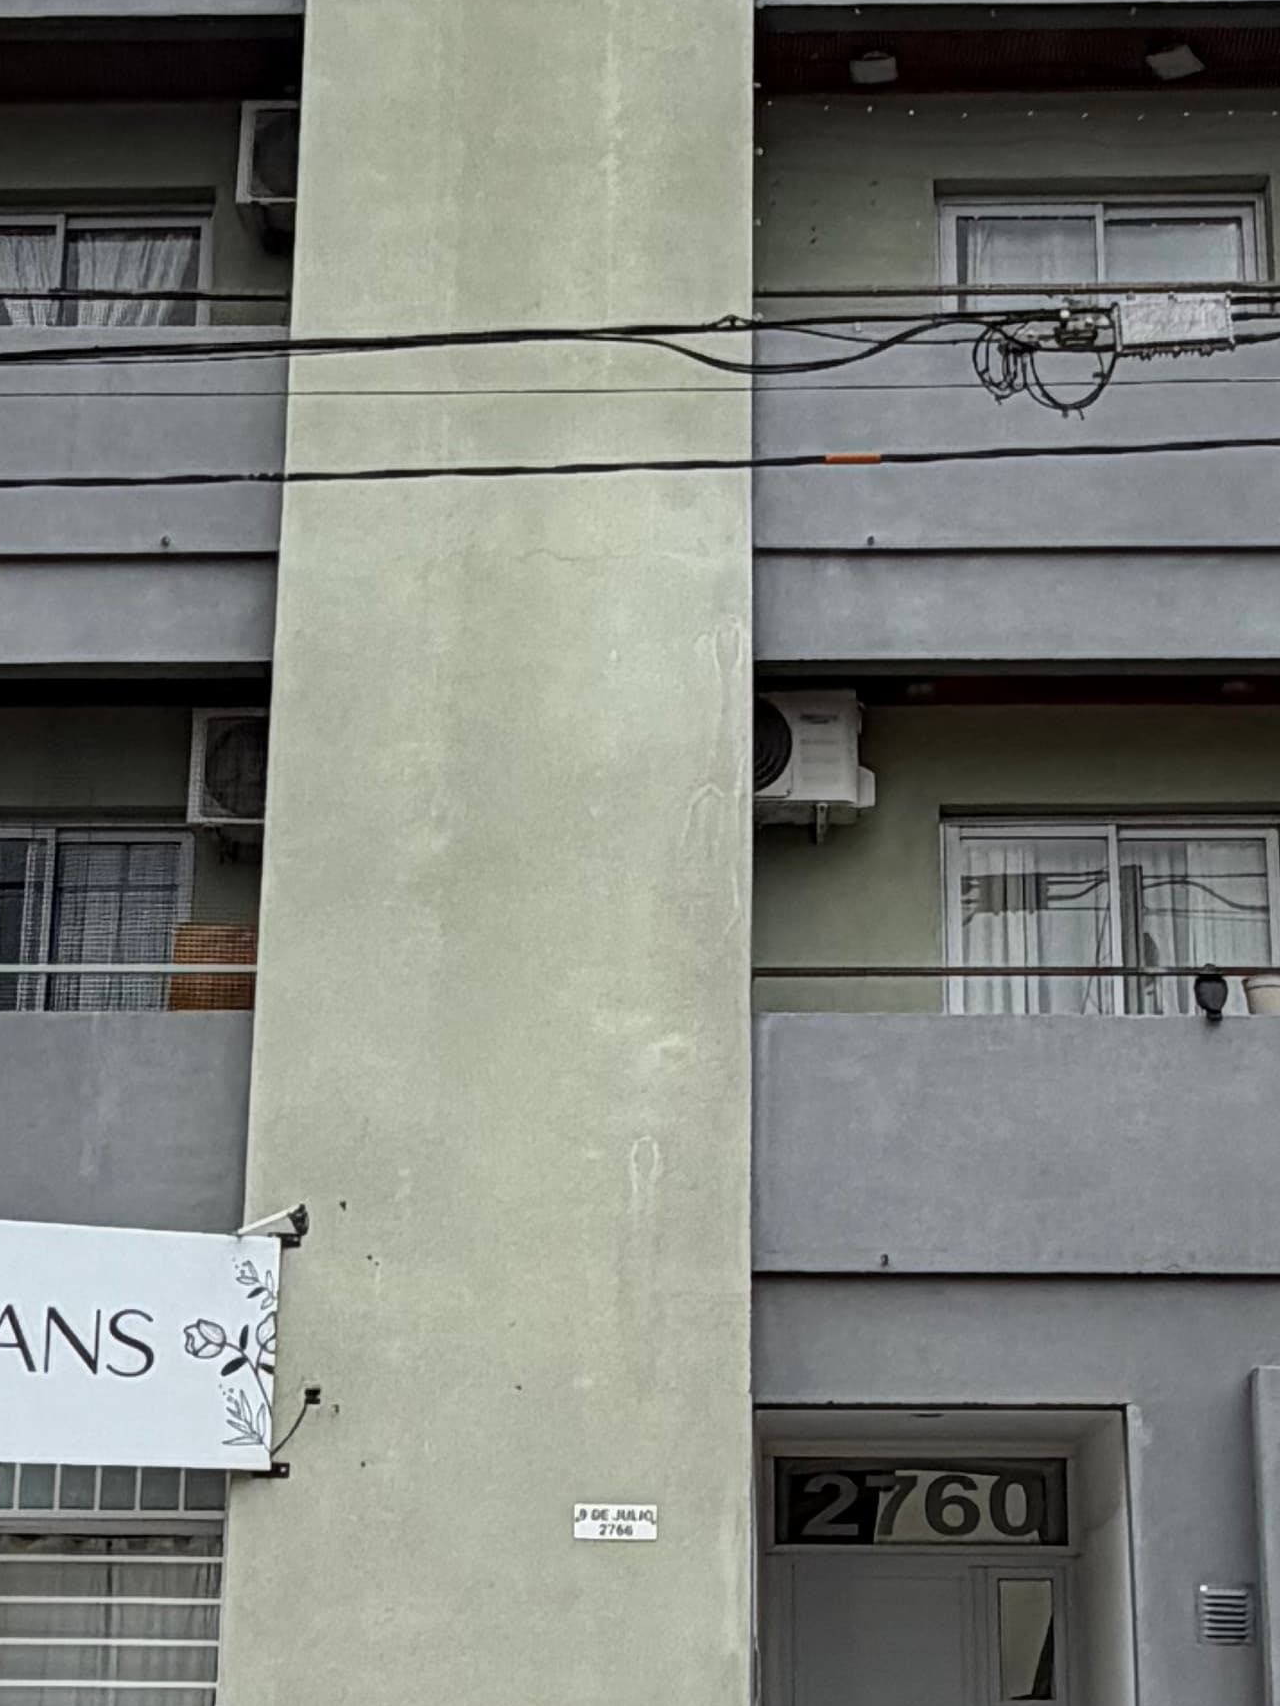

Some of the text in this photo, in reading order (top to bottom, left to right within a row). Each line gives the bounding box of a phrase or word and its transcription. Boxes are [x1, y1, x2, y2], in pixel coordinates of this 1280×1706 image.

[592, 1508, 609, 1521] DE
[615, 1509, 654, 1522] JULIO
[800, 1473, 1046, 1537] 2760
